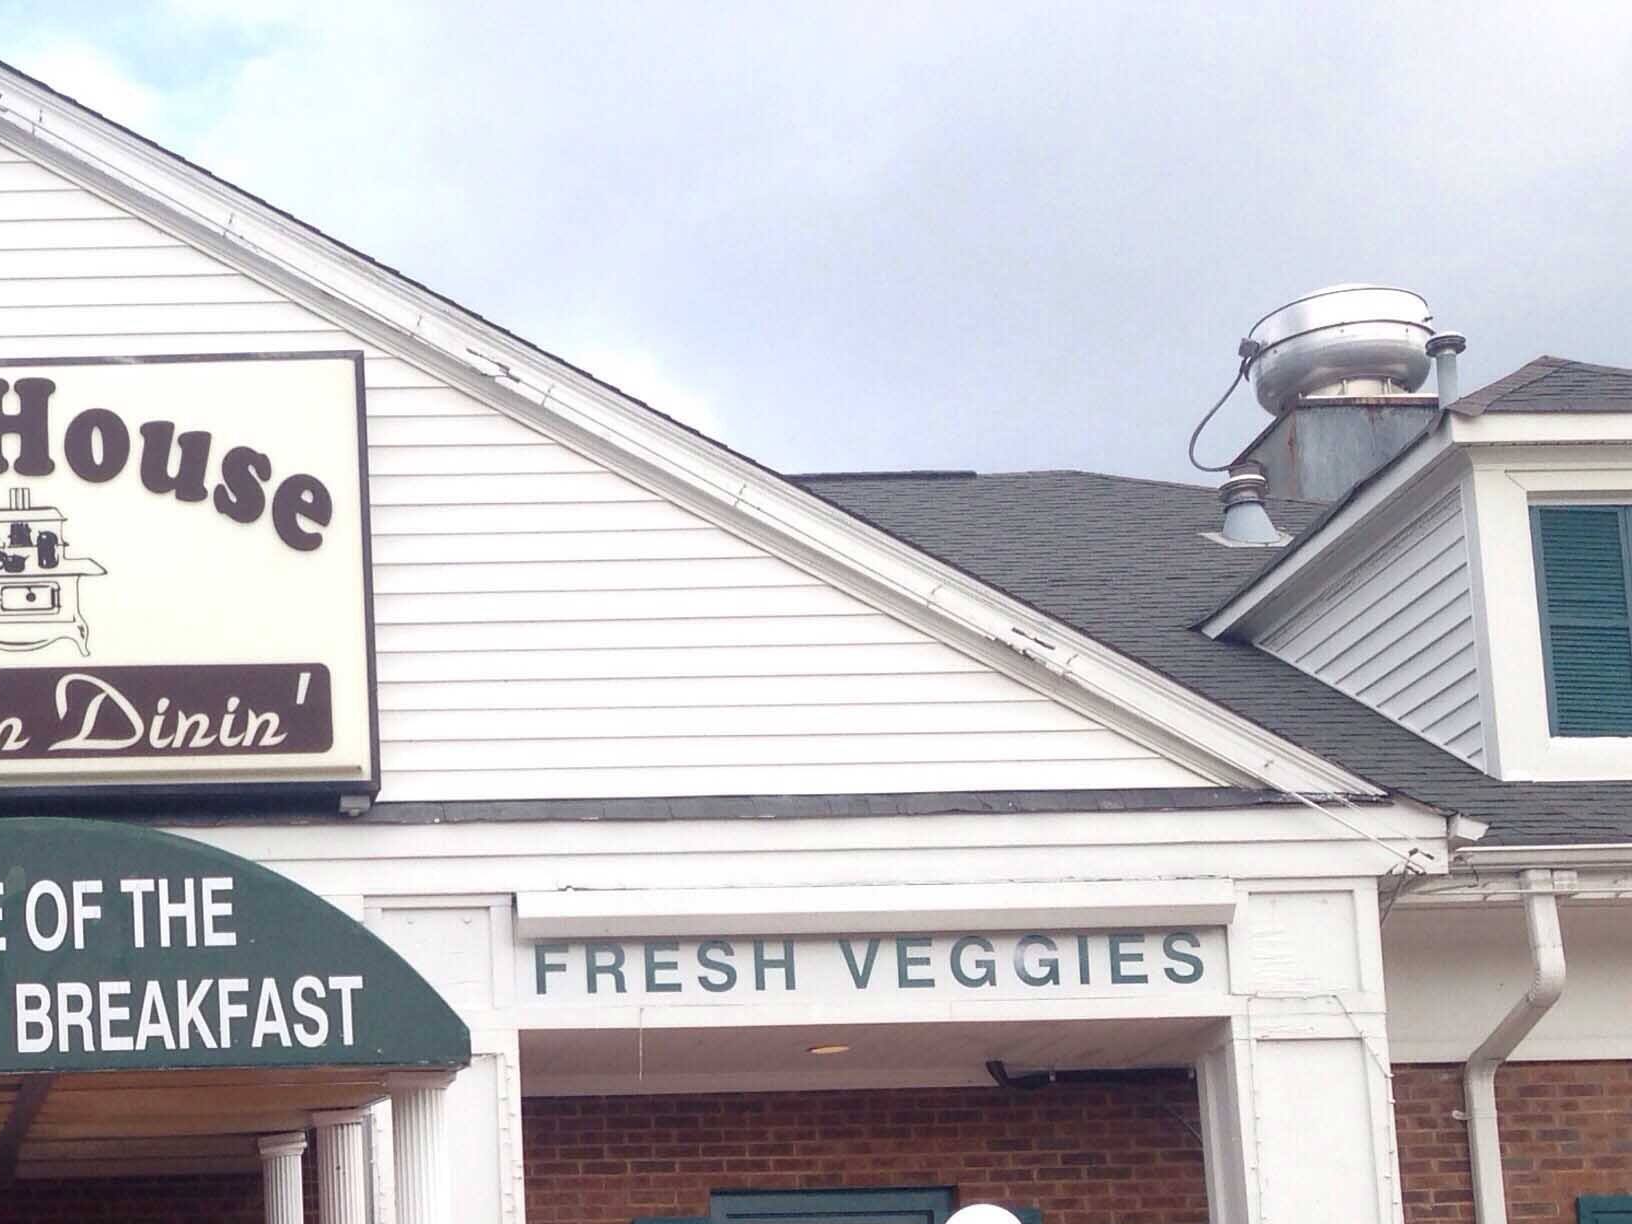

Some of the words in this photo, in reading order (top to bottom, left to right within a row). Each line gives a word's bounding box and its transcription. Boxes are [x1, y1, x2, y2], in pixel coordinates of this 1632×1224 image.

[48, 671, 311, 752] Dinin'
[24, 878, 103, 952] OF
[119, 876, 238, 949] THE
[535, 939, 796, 994] FRESH
[839, 933, 1205, 989] VEGGIES
[15, 975, 364, 1054] BREAKFAST
